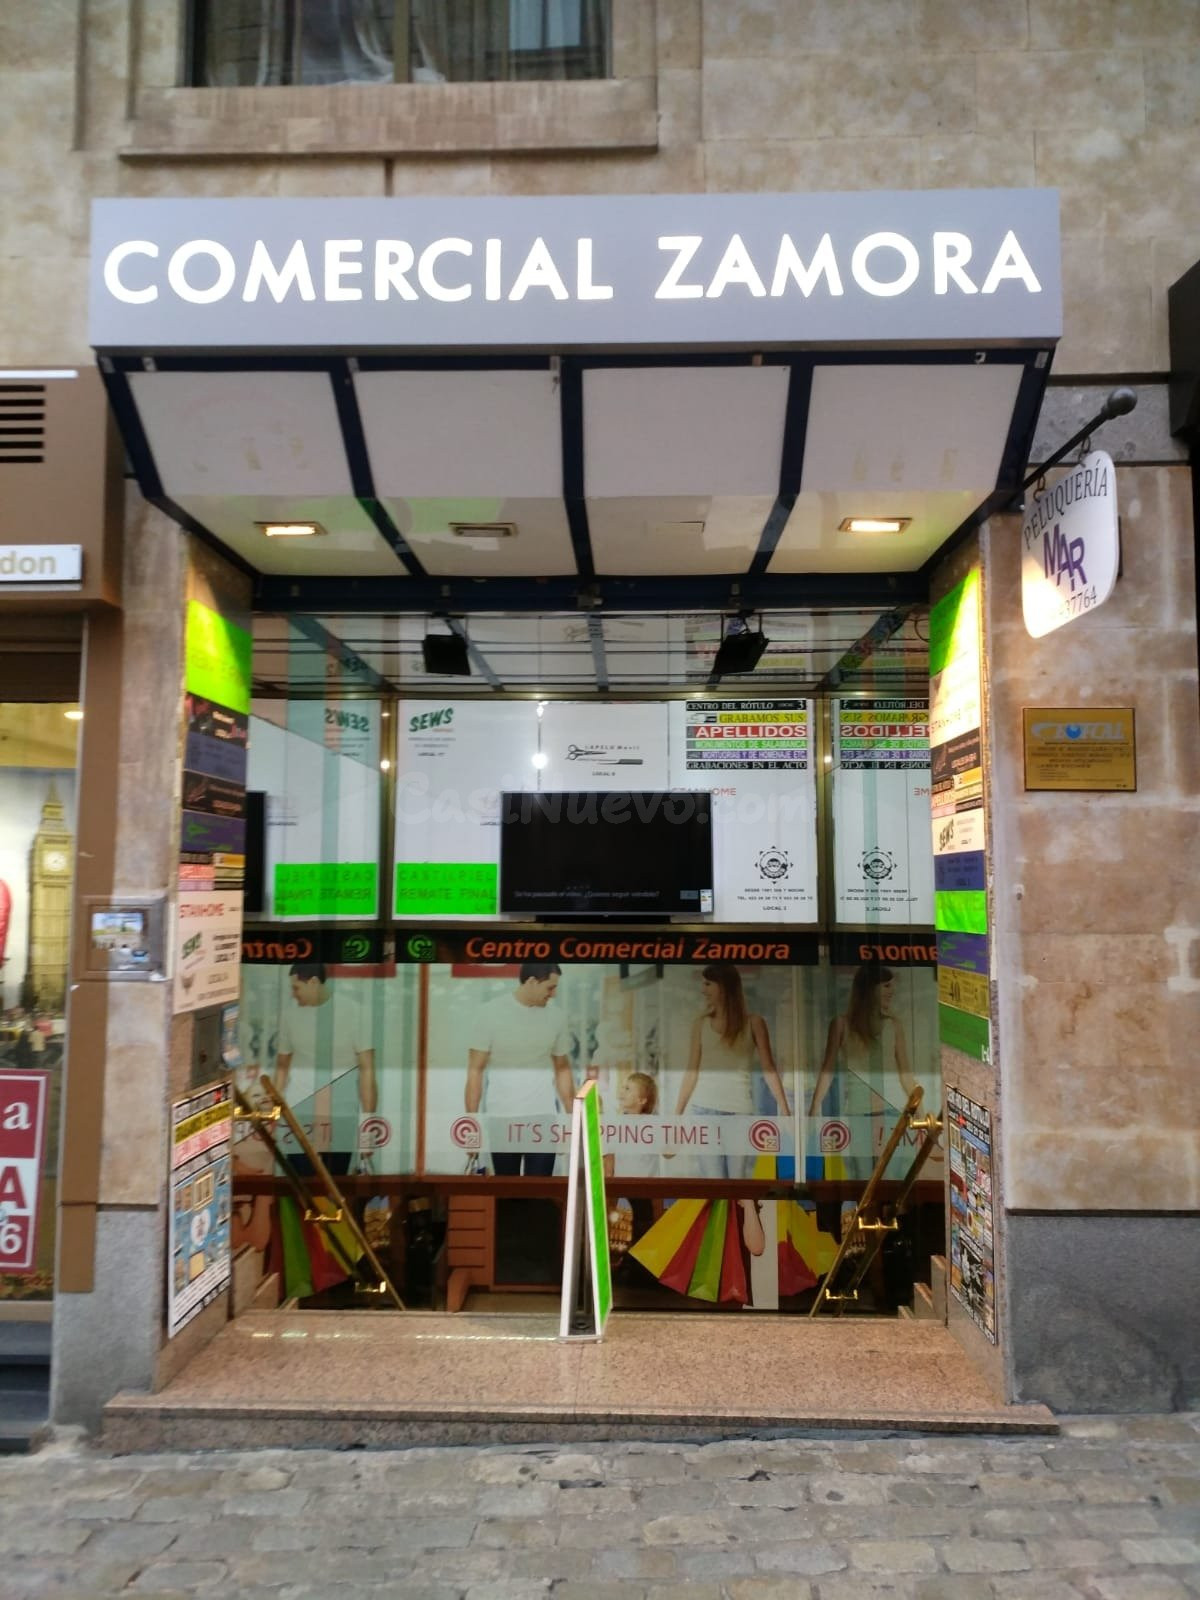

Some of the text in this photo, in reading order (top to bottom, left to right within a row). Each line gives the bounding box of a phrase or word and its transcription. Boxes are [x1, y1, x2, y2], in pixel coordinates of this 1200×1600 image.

[103, 229, 1042, 305] COMERCIAL ZAMORA
[1023, 458, 1109, 550] PELUQUERÍA
[1043, 523, 1088, 592] MAR
[686, 702, 719, 710] CENTRO
[721, 702, 737, 710] DEL
[719, 713, 804, 723] GRABAMOS SUS
[408, 707, 455, 733] SEWS
[695, 725, 806, 738] APELLIDOS
[686, 761, 807, 769] GRABACIONES EN EL ACTO
[465, 936, 790, 960] Centro Comercial Zamora
[3, 1099, 32, 1131] a
[507, 1123, 542, 1144] IT'S
[549, 1123, 655, 1145] SHPPING
[661, 1125, 710, 1145] TIME
[0, 1222, 23, 1256] 6
